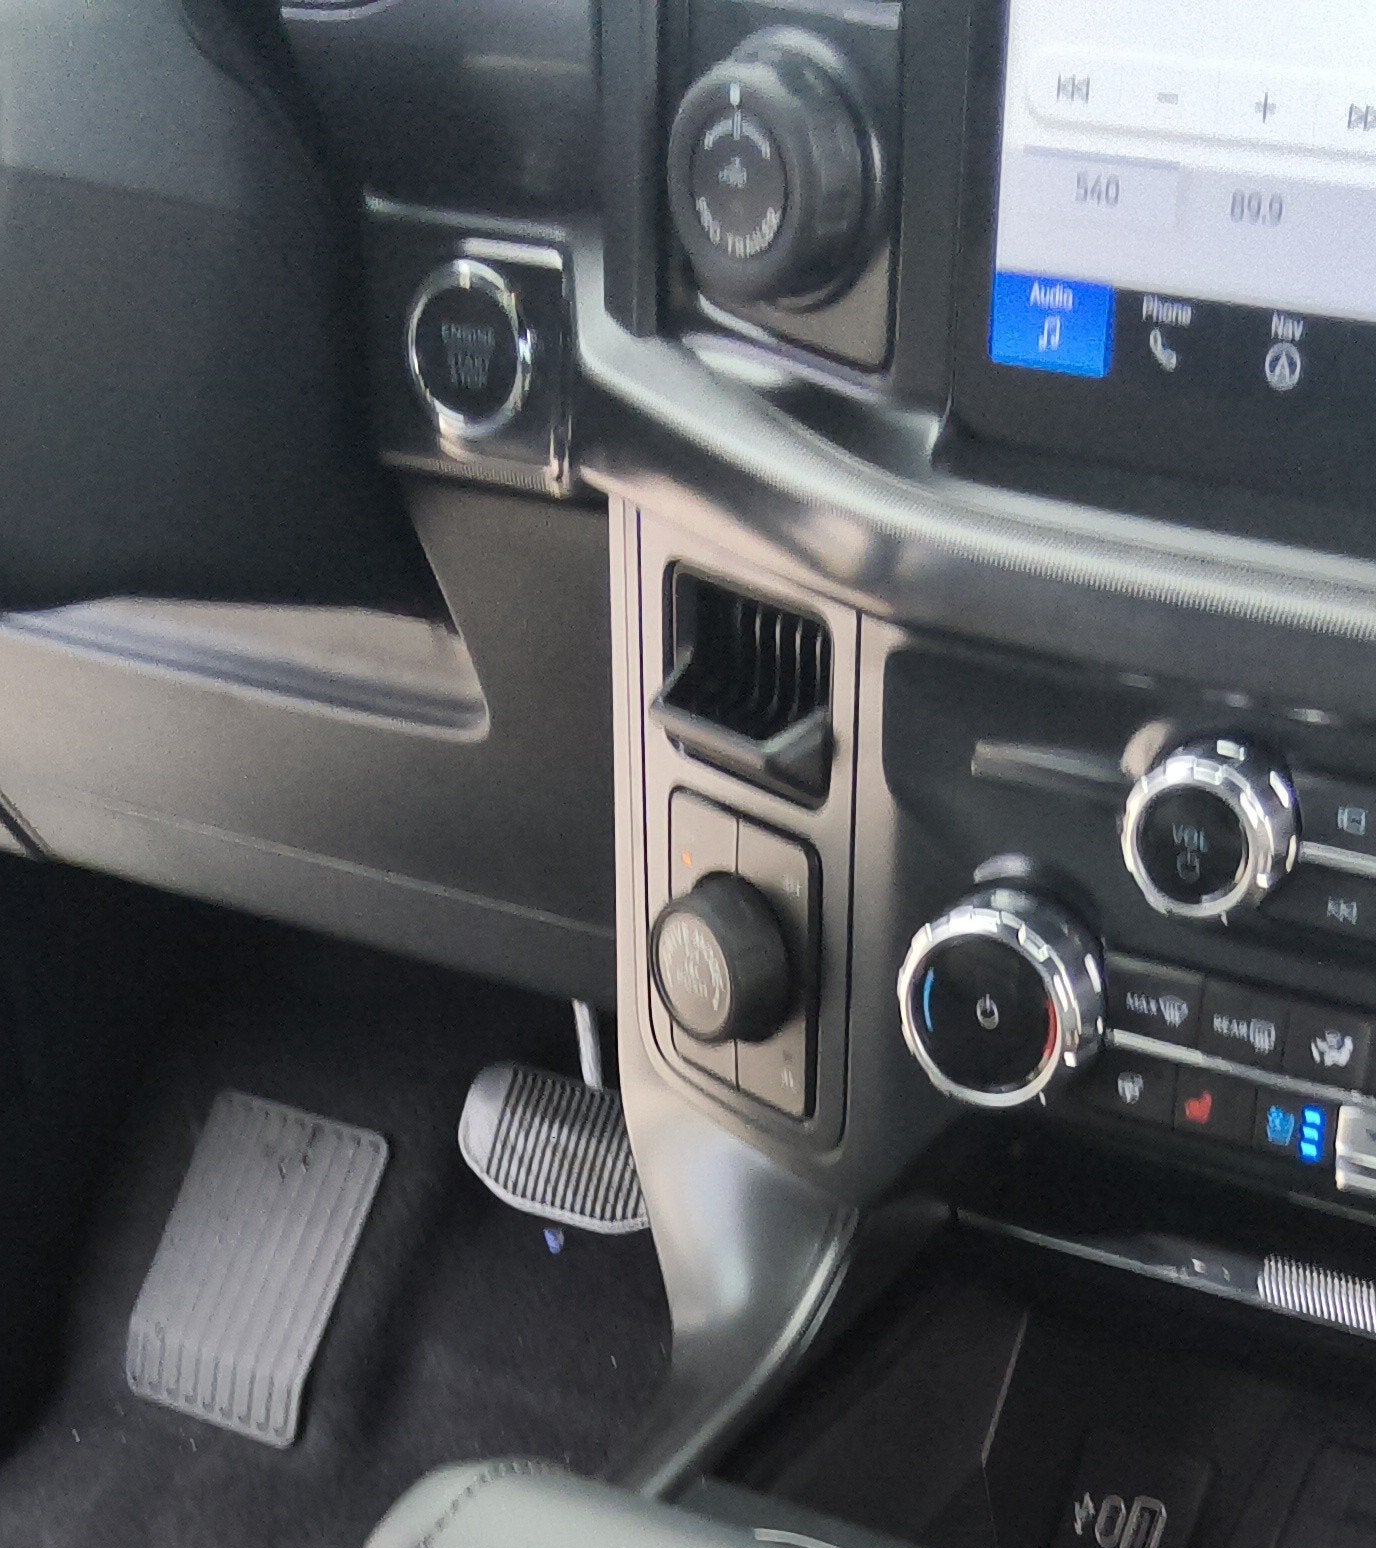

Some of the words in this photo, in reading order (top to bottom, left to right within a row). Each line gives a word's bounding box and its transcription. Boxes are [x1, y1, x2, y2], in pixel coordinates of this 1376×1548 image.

[1076, 169, 1120, 206] 540
[1029, 279, 1074, 311] Audio
[1141, 293, 1192, 328] Phone
[1271, 308, 1304, 342] Nav
